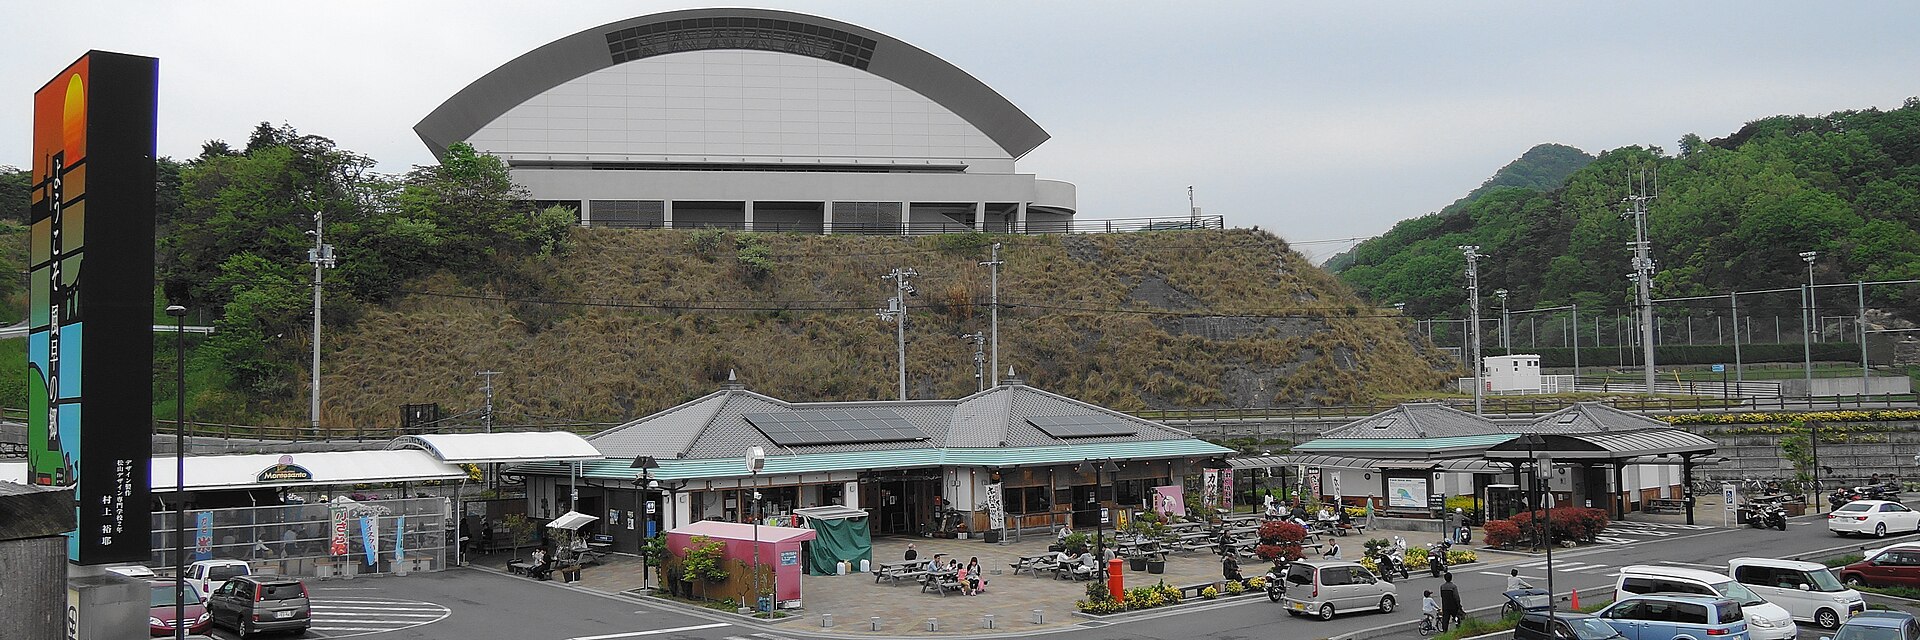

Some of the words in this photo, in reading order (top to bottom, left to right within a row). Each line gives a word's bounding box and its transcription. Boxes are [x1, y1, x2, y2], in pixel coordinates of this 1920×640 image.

[51, 158, 61, 292] ようこそ
[102, 494, 113, 517] 村上
